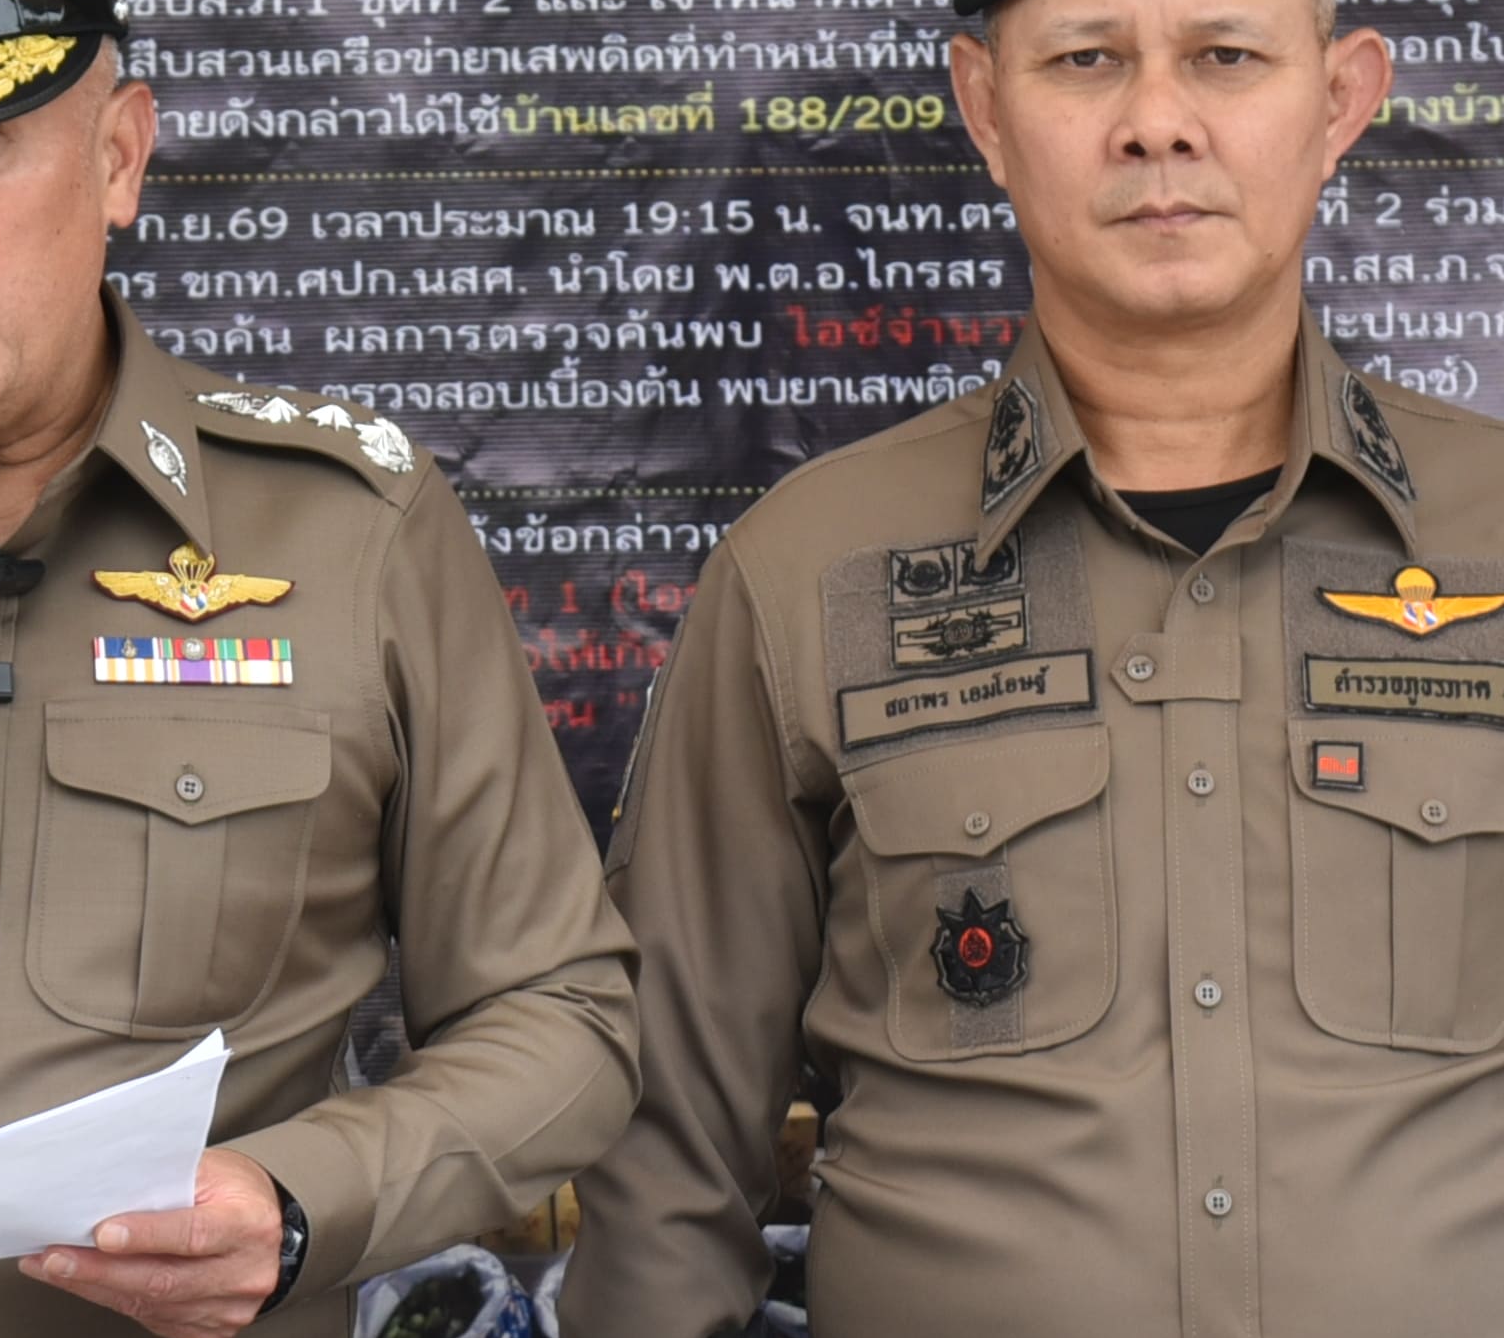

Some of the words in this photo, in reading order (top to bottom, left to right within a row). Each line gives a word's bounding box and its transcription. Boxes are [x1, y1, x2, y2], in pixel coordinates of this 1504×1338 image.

[739, 93, 947, 133] 188/209
[136, 206, 290, 242] ก.ย.69
[311, 201, 596, 240] เวลาประมาณ
[622, 200, 756, 235] 19:15
[775, 203, 824, 232] น.
[845, 201, 1019, 233] จนท.ตร
[1375, 192, 1404, 226] 2
[180, 259, 528, 299] ขกท.ศปก.นสศ.
[548, 251, 695, 294] นำโดย
[716, 248, 1006, 293] พ.ต.อ.ไกรสร
[145, 313, 294, 356] วจค้น
[323, 312, 764, 355] ผลการตรวจค้นพบ
[788, 305, 1029, 350] ไอซ์จำนว
[610, 569, 698, 615] (ไอ
[1334, 667, 1492, 707] ตำรวจภูธรภาค
